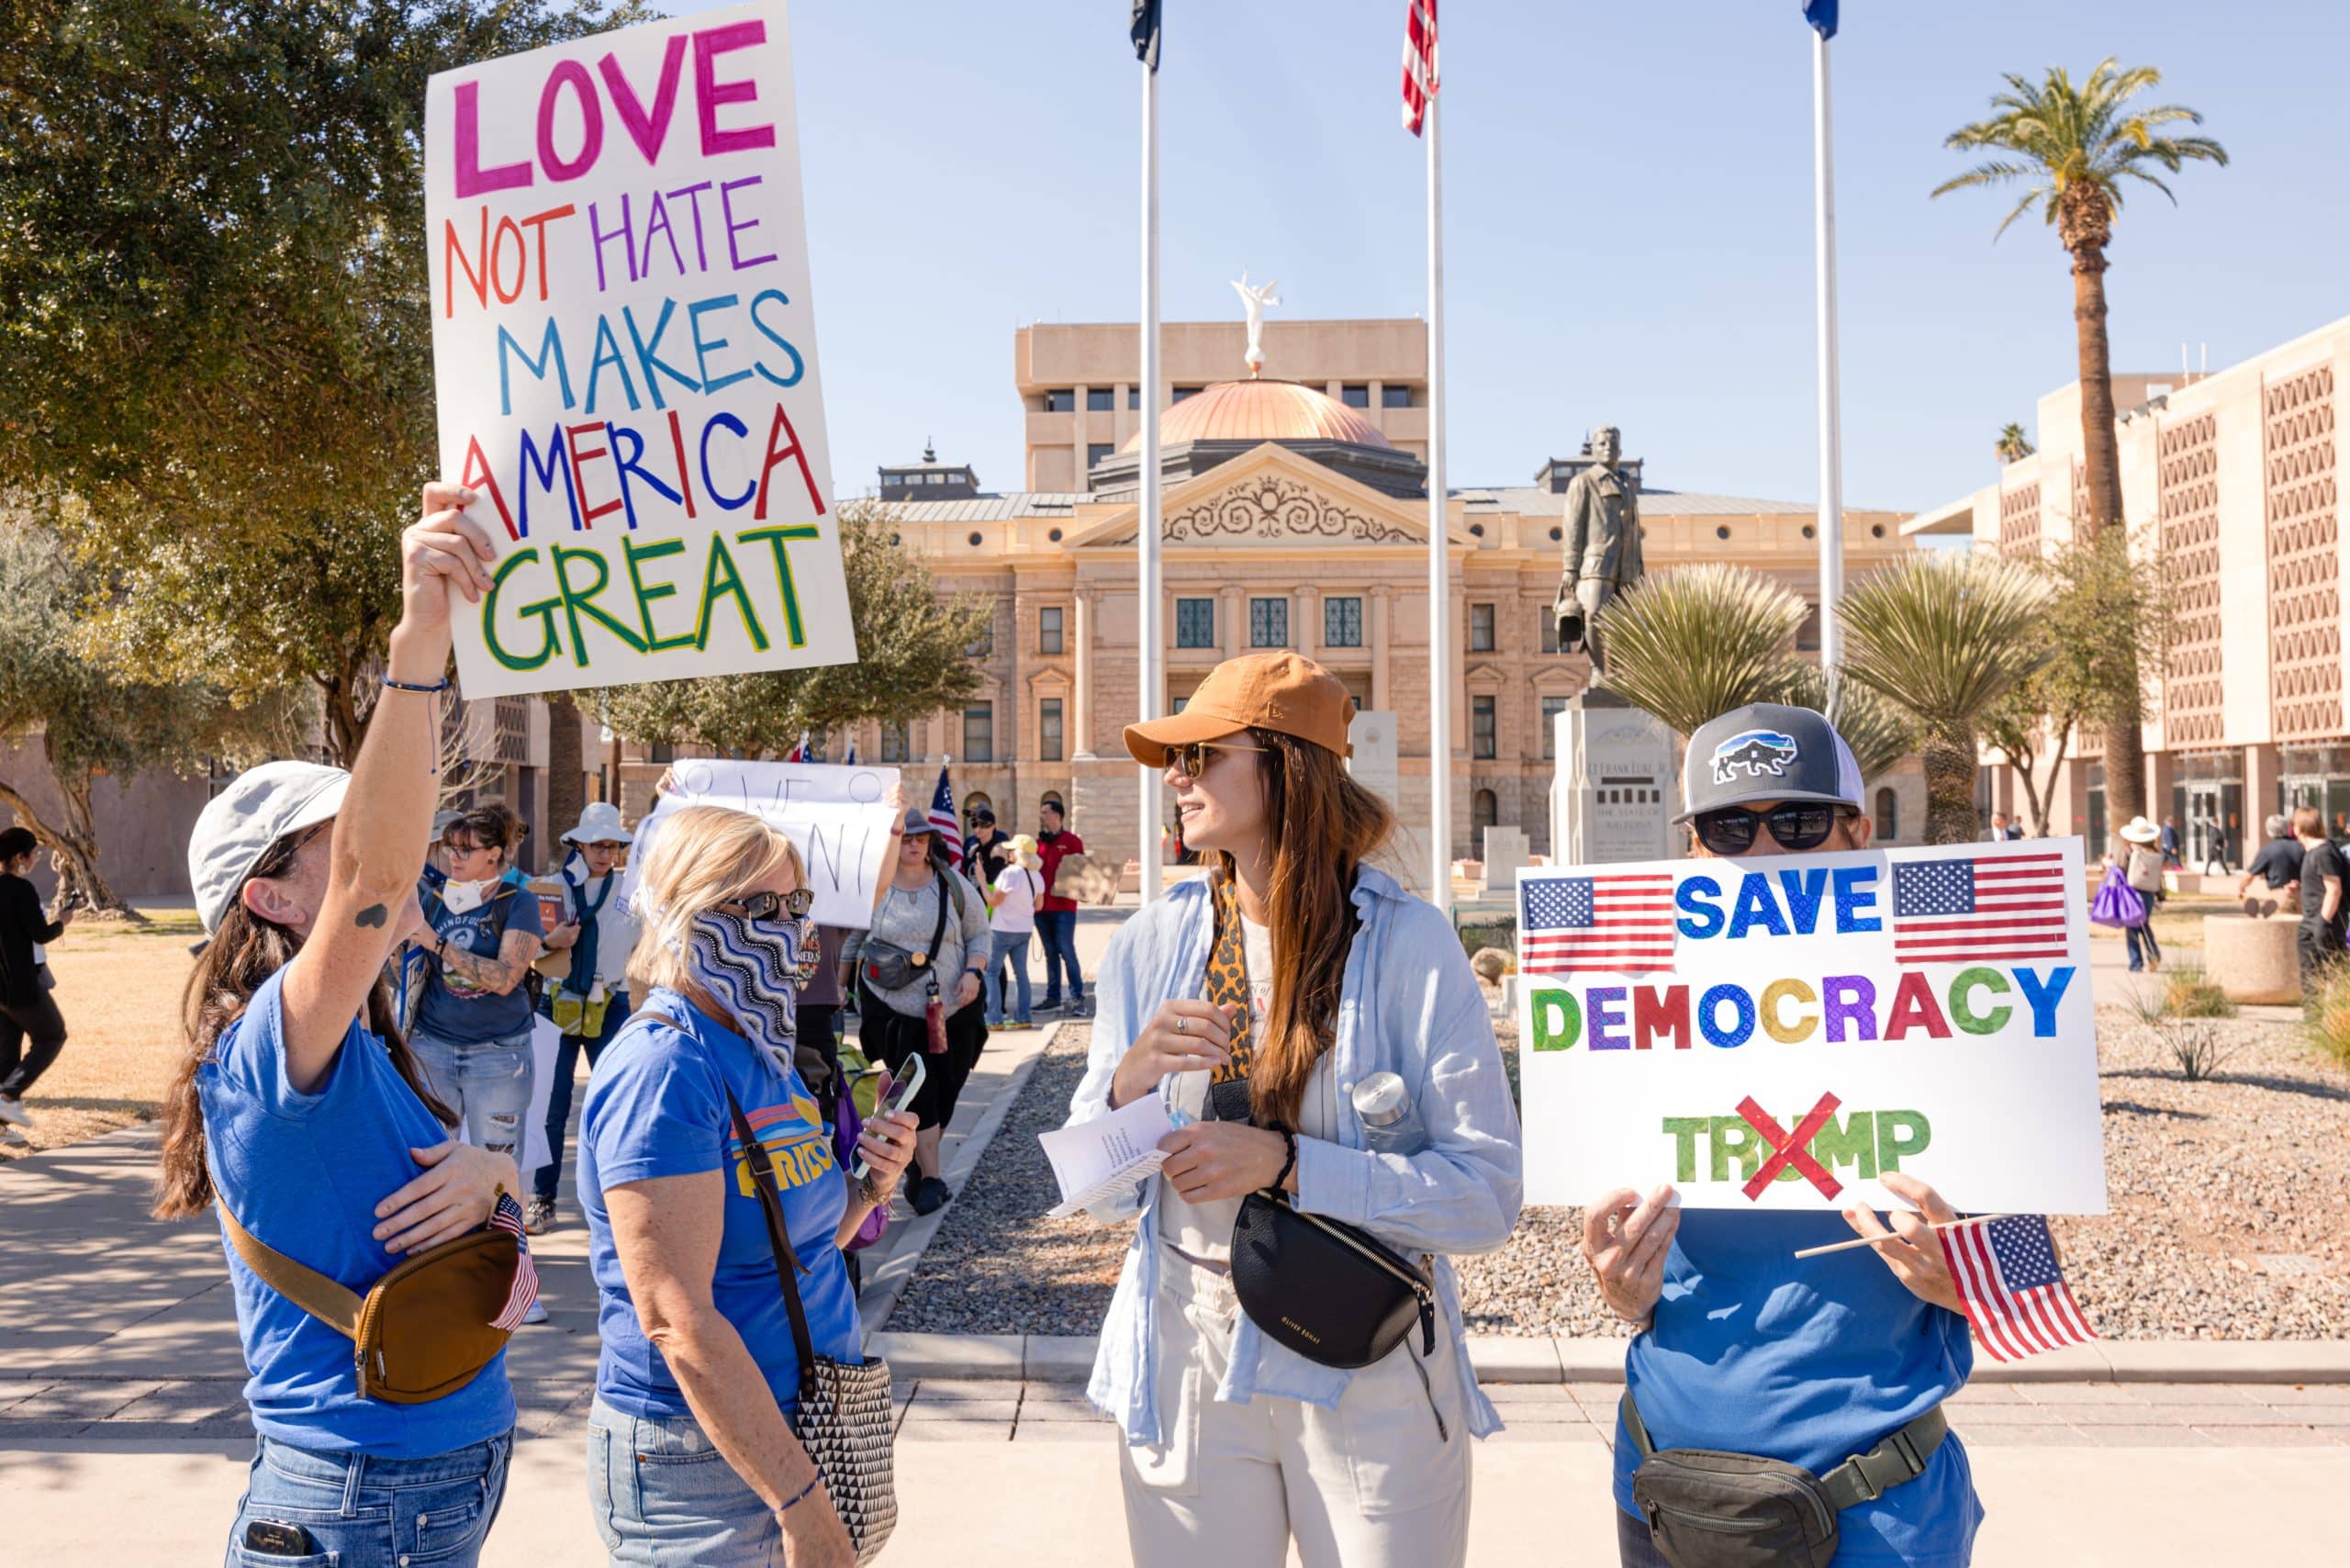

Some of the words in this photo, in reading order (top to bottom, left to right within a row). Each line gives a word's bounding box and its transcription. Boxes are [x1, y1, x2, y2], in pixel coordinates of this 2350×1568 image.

[454, 19, 777, 199] LOVE
[445, 203, 576, 319] NOT
[588, 175, 778, 292] HATE
[498, 288, 805, 416] MAKES
[463, 402, 826, 543] AMERICA
[482, 524, 821, 673] GREAT
[1675, 866, 1883, 939] SAVE
[1530, 966, 2076, 1052] DEMOCRACY
